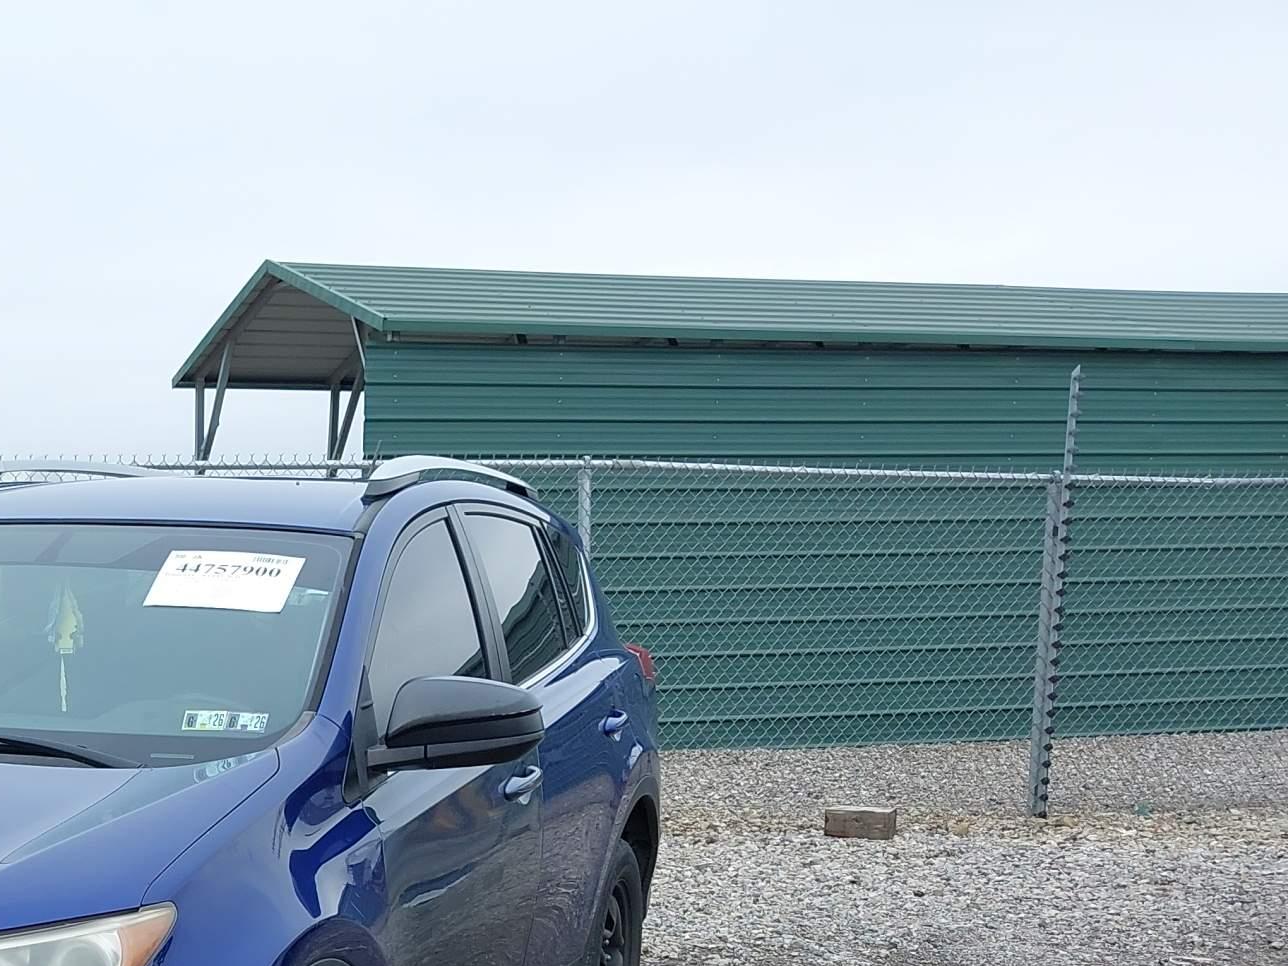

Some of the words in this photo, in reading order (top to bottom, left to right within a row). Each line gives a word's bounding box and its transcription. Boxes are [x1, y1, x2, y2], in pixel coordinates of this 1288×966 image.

[176, 563, 281, 578] 44757900
[213, 713, 225, 727] 26
[254, 715, 266, 729] 26
